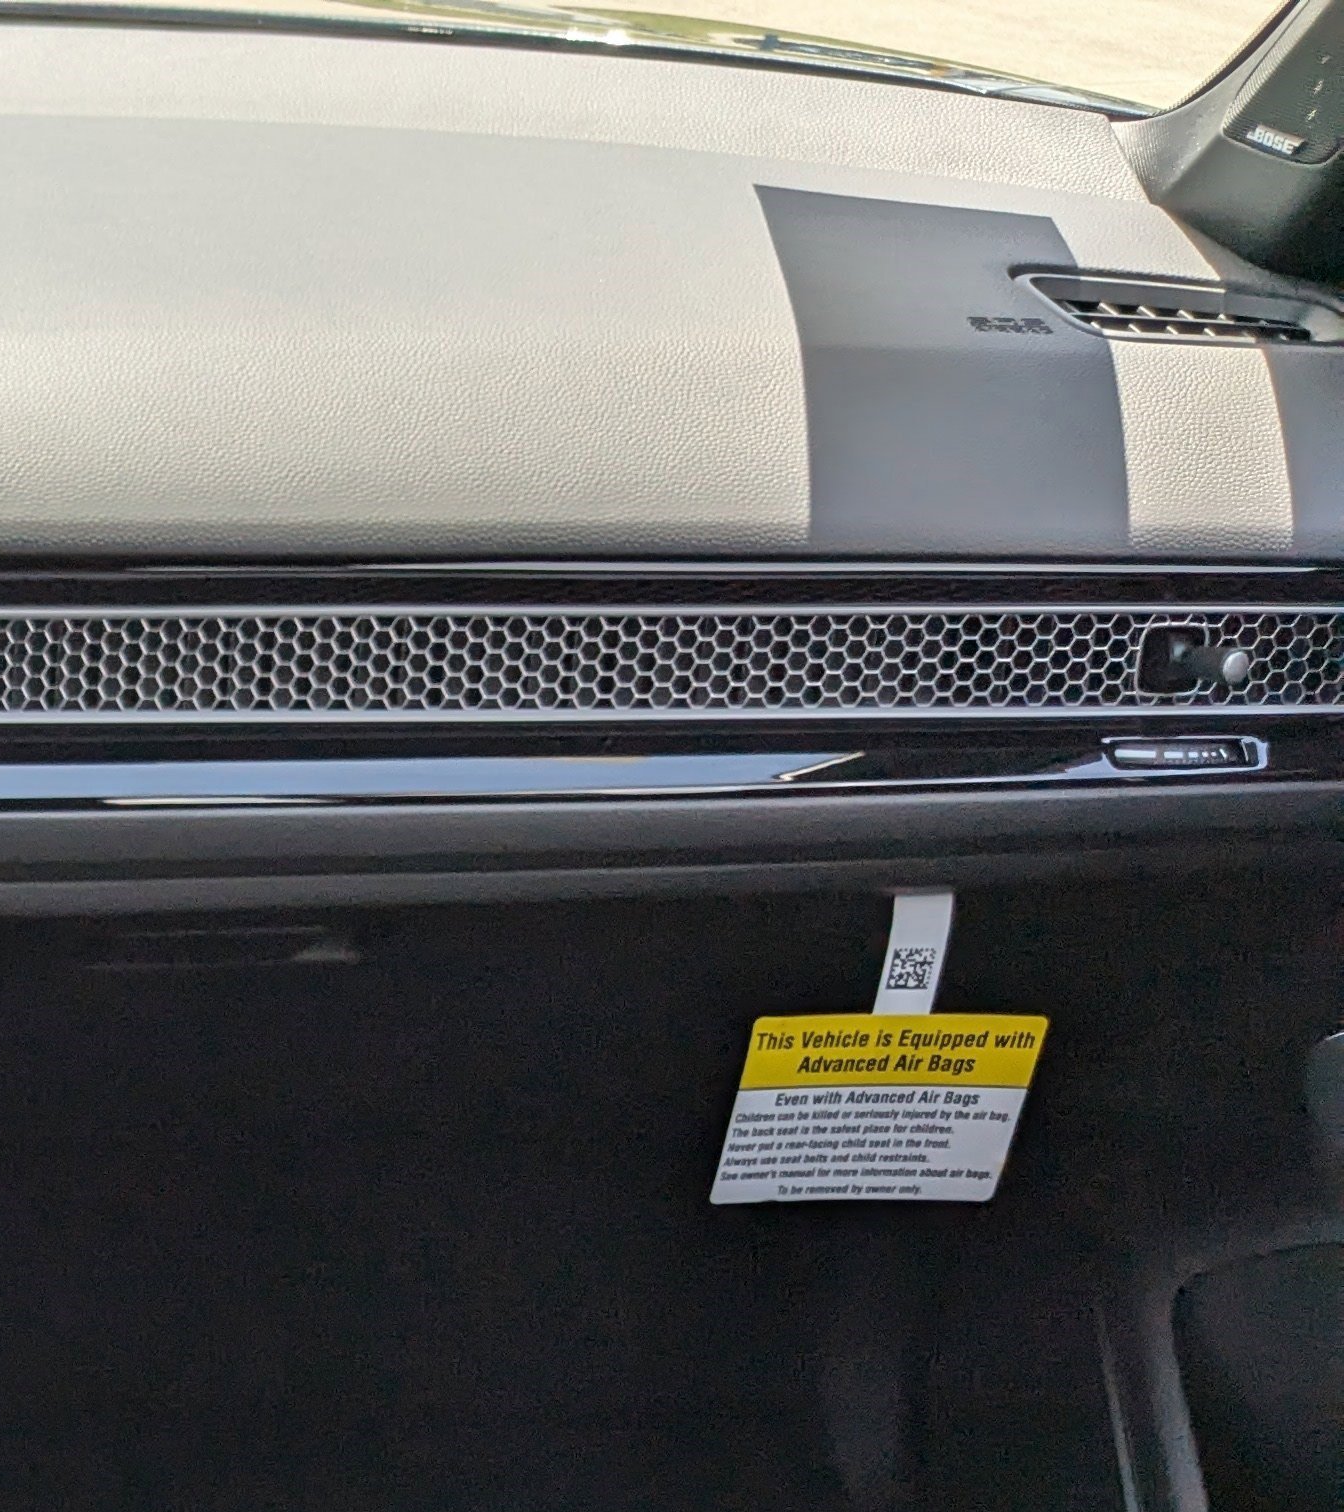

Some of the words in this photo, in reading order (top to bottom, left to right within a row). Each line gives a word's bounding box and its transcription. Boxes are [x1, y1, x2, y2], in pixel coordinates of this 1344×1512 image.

[1246, 127, 1300, 155] BOSE
[756, 1032, 795, 1051] This
[801, 1030, 870, 1048] Vehicle
[876, 1029, 893, 1047] is
[898, 1029, 989, 1050] Equipped
[994, 1031, 1035, 1049] with
[797, 1055, 890, 1073] Advanced
[893, 1054, 923, 1072] Air
[927, 1054, 976, 1076] Bags
[775, 1093, 809, 1107] Even
[813, 1091, 842, 1105] with
[845, 1091, 915, 1105] Advanced
[918, 1091, 941, 1104] Air
[943, 1091, 980, 1107] Bags
[735, 1112, 776, 1123] Children
[777, 1112, 795, 1121] can
[797, 1111, 809, 1120] be
[812, 1110, 840, 1120] killed
[841, 1110, 852, 1119] or
[854, 1109, 899, 1120] seriously
[902, 1109, 937, 1120] injured
[940, 1110, 952, 1121] by
[954, 1110, 970, 1120] the
[972, 1110, 988, 1120] air
[989, 1111, 1011, 1123] bag.
[732, 1127, 749, 1137] The
[752, 1127, 775, 1137] back
[776, 1126, 798, 1136] seat
[801, 1126, 810, 1135] is
[812, 1125, 828, 1134] the
[831, 1124, 861, 1134] safest
[863, 1124, 891, 1135] place
[893, 1124, 907, 1133] for
[910, 1124, 954, 1134] children.
[727, 1143, 755, 1152] Never
[757, 1142, 775, 1152] put
[785, 1140, 839, 1150] rear-facing
[842, 1138, 866, 1148] child
[869, 1139, 891, 1148] seat
[893, 1139, 903, 1148] in
[905, 1139, 922, 1148] the
[924, 1139, 951, 1149] front.
[723, 1157, 757, 1167] Always
[760, 1156, 777, 1165] use
[779, 1155, 802, 1164] seat
[803, 1154, 828, 1163] belts
[830, 1153, 850, 1163] and
[851, 1152, 877, 1162] child
[879, 1153, 930, 1163] restraints.
[720, 1171, 738, 1181] See
[740, 1170, 777, 1180] owner's
[779, 1168, 815, 1178] manual
[817, 1168, 831, 1177] for
[833, 1168, 858, 1177] more
[860, 1167, 917, 1177] information
[919, 1168, 948, 1178] about
[949, 1168, 964, 1178] air
[966, 1169, 992, 1180] bags.
[777, 1185, 788, 1195] To
[790, 1185, 802, 1195] be
[805, 1185, 849, 1194] removed
[851, 1185, 863, 1195] by
[865, 1185, 896, 1193] owner
